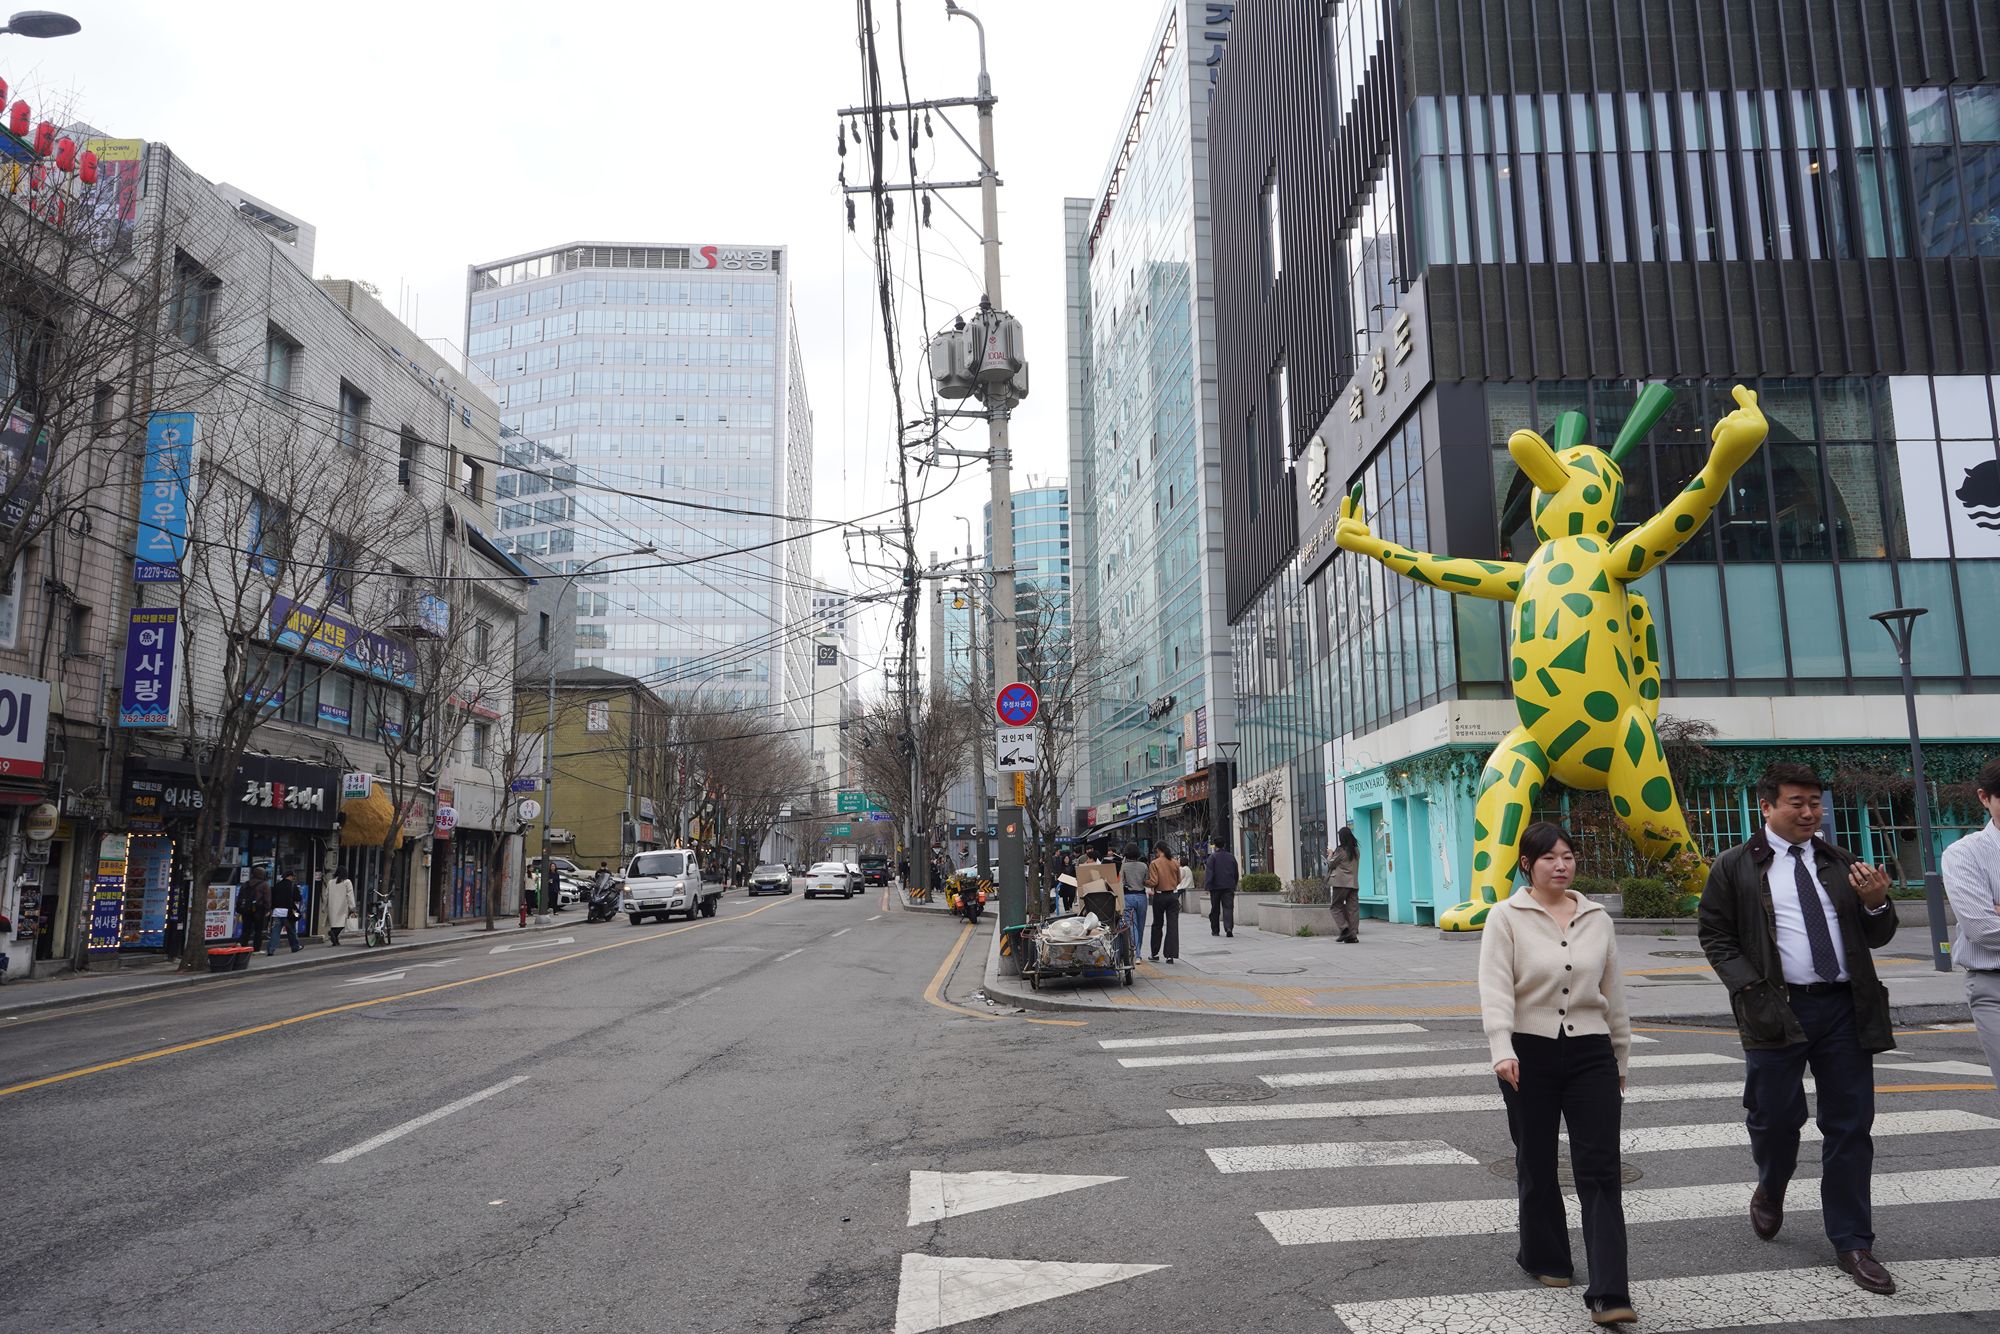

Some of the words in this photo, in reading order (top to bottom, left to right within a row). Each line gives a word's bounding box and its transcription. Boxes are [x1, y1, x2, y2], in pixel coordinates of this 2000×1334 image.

[721, 250, 768, 271] 쌍용
[1350, 311, 1414, 424] 숙성도
[819, 647, 835, 659] G2
[134, 627, 165, 702] 어사랑
[1003, 700, 1032, 708] 주정차금지
[123, 713, 167, 723] 752-8328
[1001, 733, 1033, 743] 견인지역
[164, 787, 204, 809] 어사랑
[435, 815, 454, 826] 부동산
[94, 915, 118, 929] 어사랑
